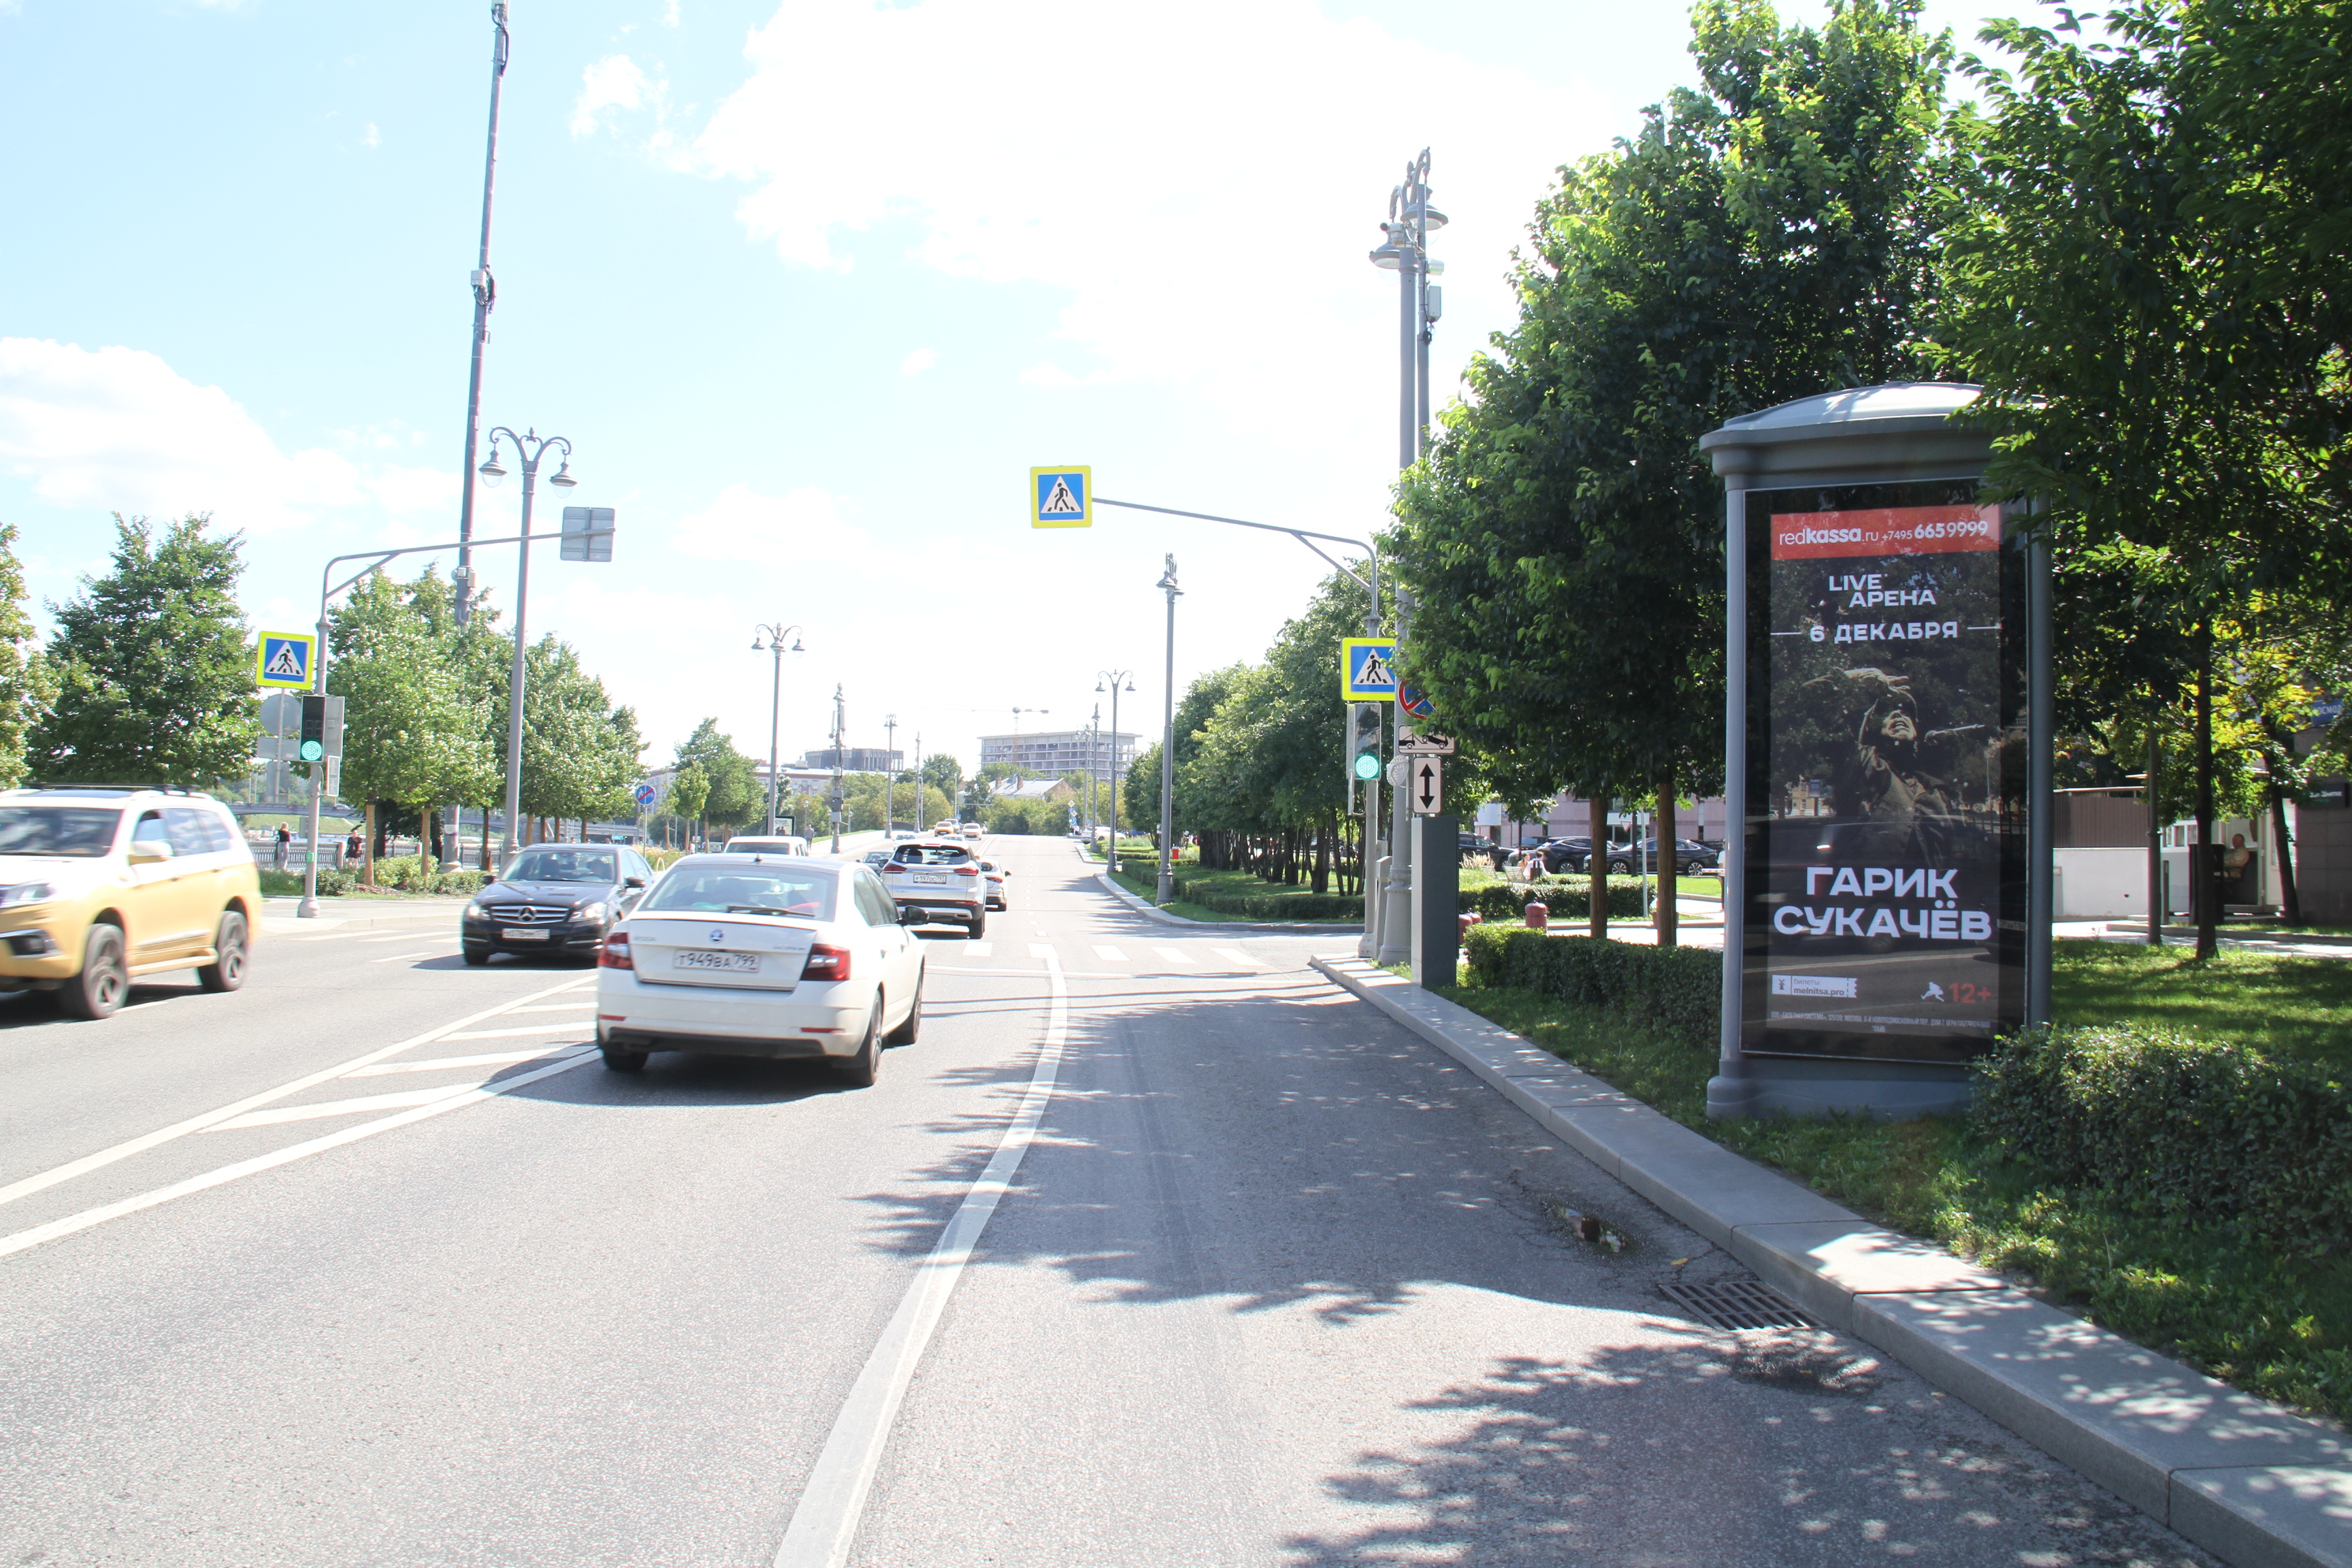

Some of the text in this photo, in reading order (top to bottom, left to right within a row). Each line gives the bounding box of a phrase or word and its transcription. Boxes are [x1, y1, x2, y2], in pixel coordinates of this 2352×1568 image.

[1779, 527, 1878, 545] redkassa.ru
[1848, 589, 1937, 608] АРЕНА
[1810, 621, 1959, 644] 6 ДЕКАБРЯ
[1807, 866, 1959, 898] ГАРИК
[1774, 900, 1992, 940] СУКАЧЁВ
[1793, 977, 1820, 985] билеты
[1793, 987, 1844, 997] melnitsa.pro
[1948, 983, 1993, 1003] 12+
